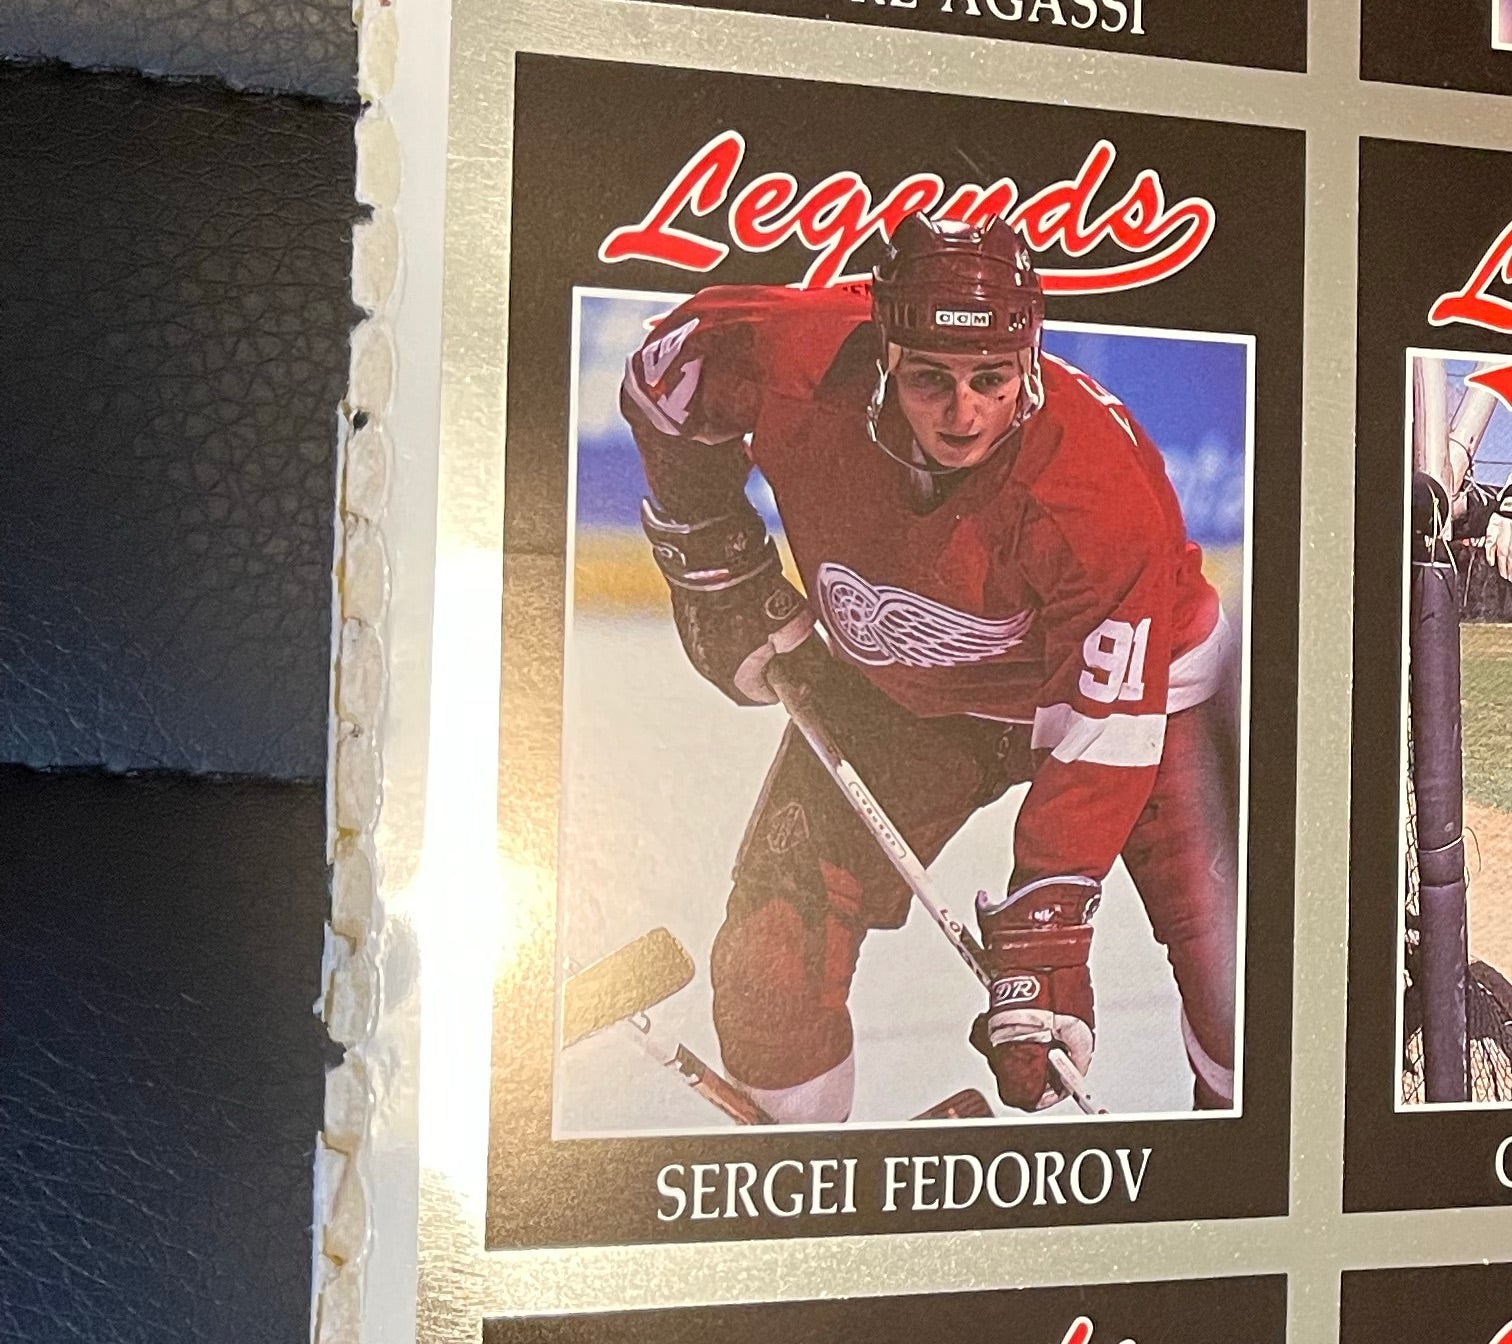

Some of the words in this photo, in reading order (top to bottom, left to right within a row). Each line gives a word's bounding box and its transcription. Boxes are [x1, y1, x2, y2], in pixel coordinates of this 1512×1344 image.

[937, 312, 989, 326] CCM
[1079, 617, 1152, 703] 91
[657, 1158, 858, 1222] SERGEI
[881, 1147, 1152, 1214] FEDOROV
